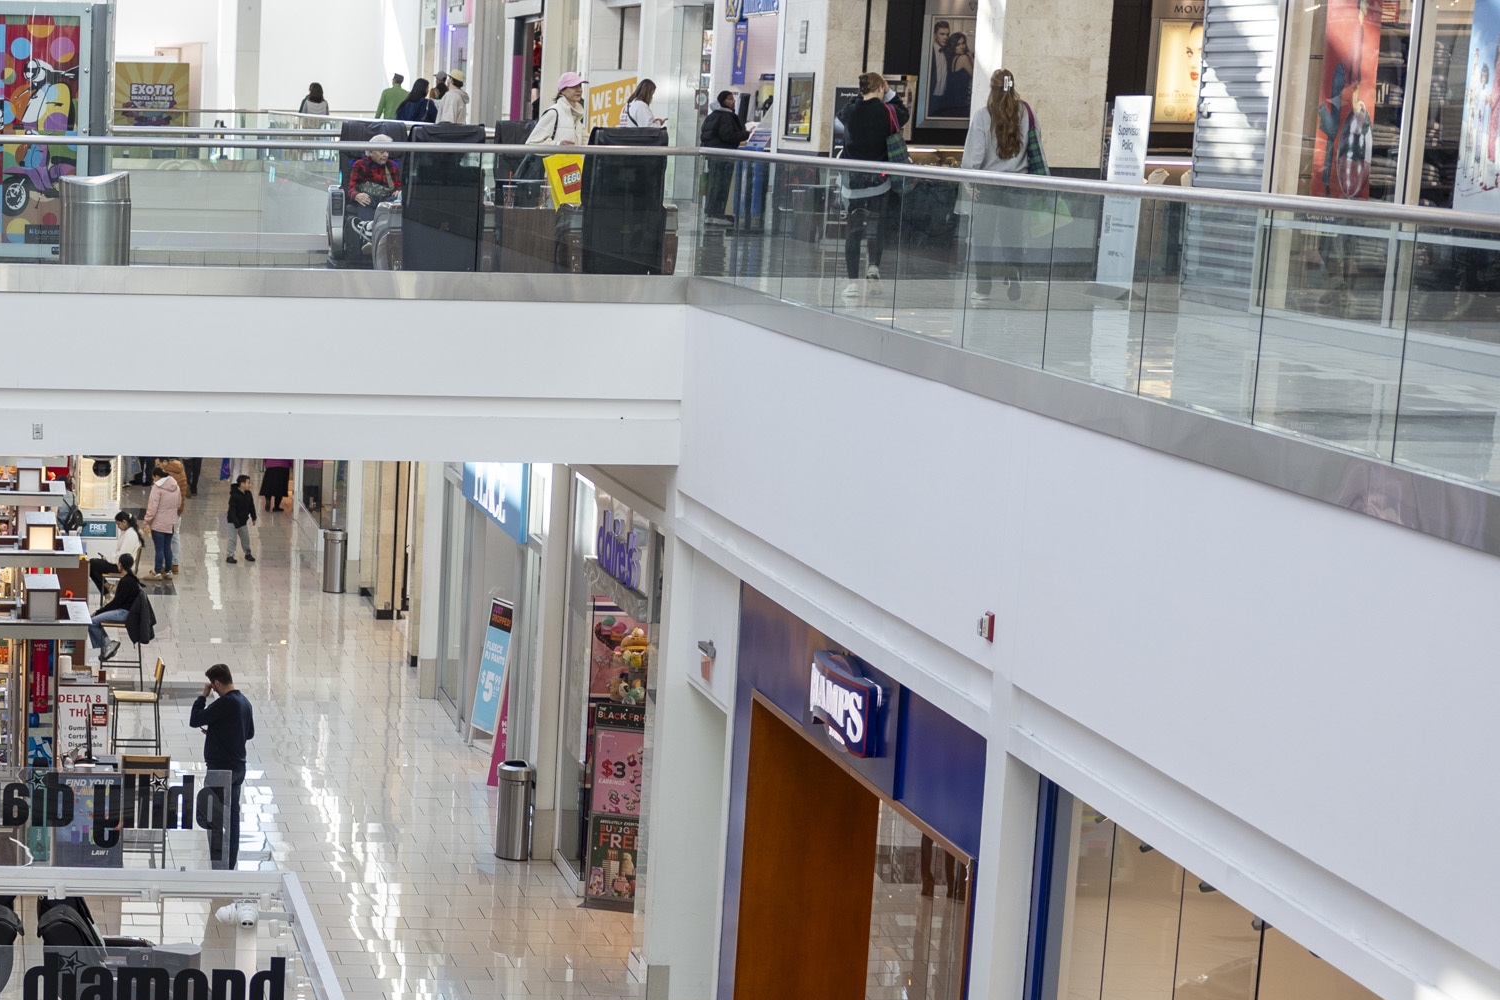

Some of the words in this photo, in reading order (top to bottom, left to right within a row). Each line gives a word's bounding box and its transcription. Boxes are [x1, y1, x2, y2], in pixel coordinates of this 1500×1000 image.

[131, 84, 174, 96] EXOTIC
[591, 89, 612, 112] WE
[562, 171, 581, 186] LEGO
[89, 523, 107, 531] FREE
[486, 640, 503, 655] FLEECE
[491, 652, 506, 666] PANTS
[58, 694, 92, 704] DELTA
[95, 694, 102, 703] 8
[598, 711, 626, 720] BLACK
[601, 759, 626, 778] $3
[66, 778, 87, 787] FIND
[600, 824, 618, 833] BUY
